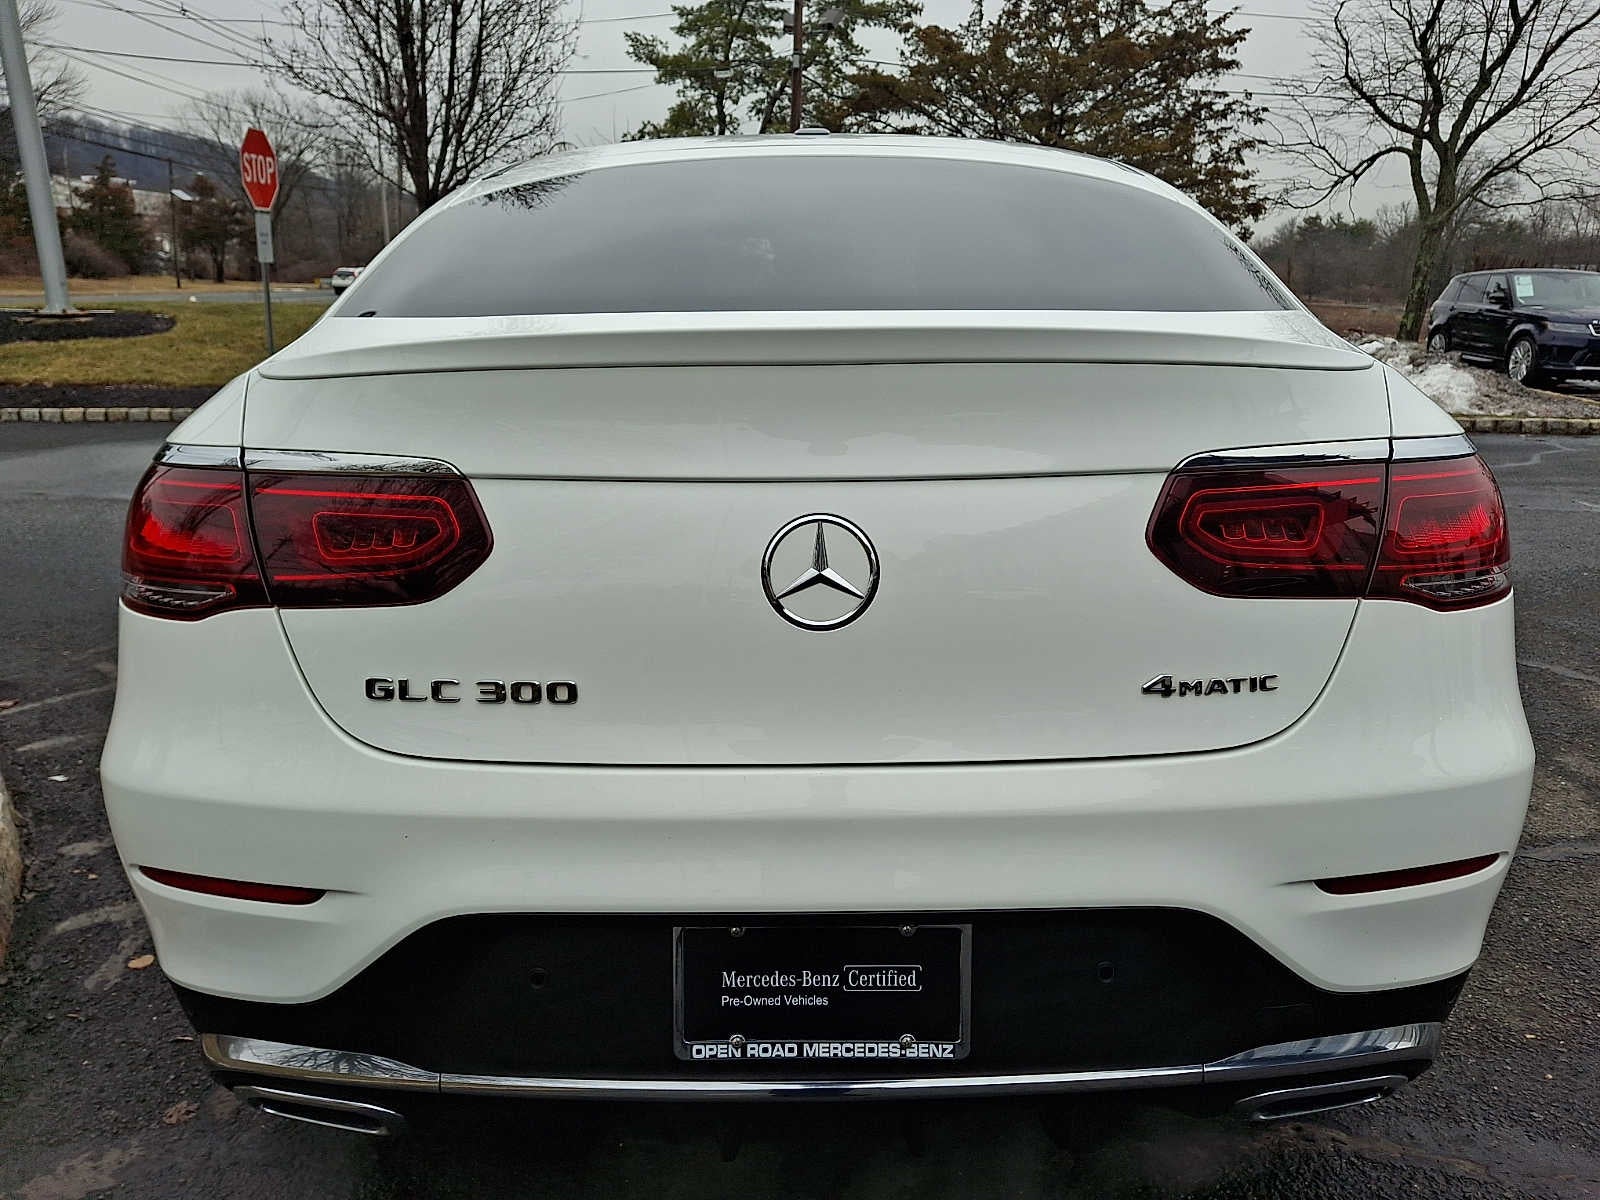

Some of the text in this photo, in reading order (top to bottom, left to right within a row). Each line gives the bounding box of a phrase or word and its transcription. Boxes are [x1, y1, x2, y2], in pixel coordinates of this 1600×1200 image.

[243, 152, 275, 185] STOP
[365, 677, 578, 704] GLC 300
[1141, 673, 1279, 698] 4MATIC
[721, 969, 917, 988] Mercedes-Benz Certified
[721, 994, 829, 1007] Pre-Owned Vehicles
[692, 1044, 741, 1059] OPEN
[746, 1043, 798, 1058] ROAD
